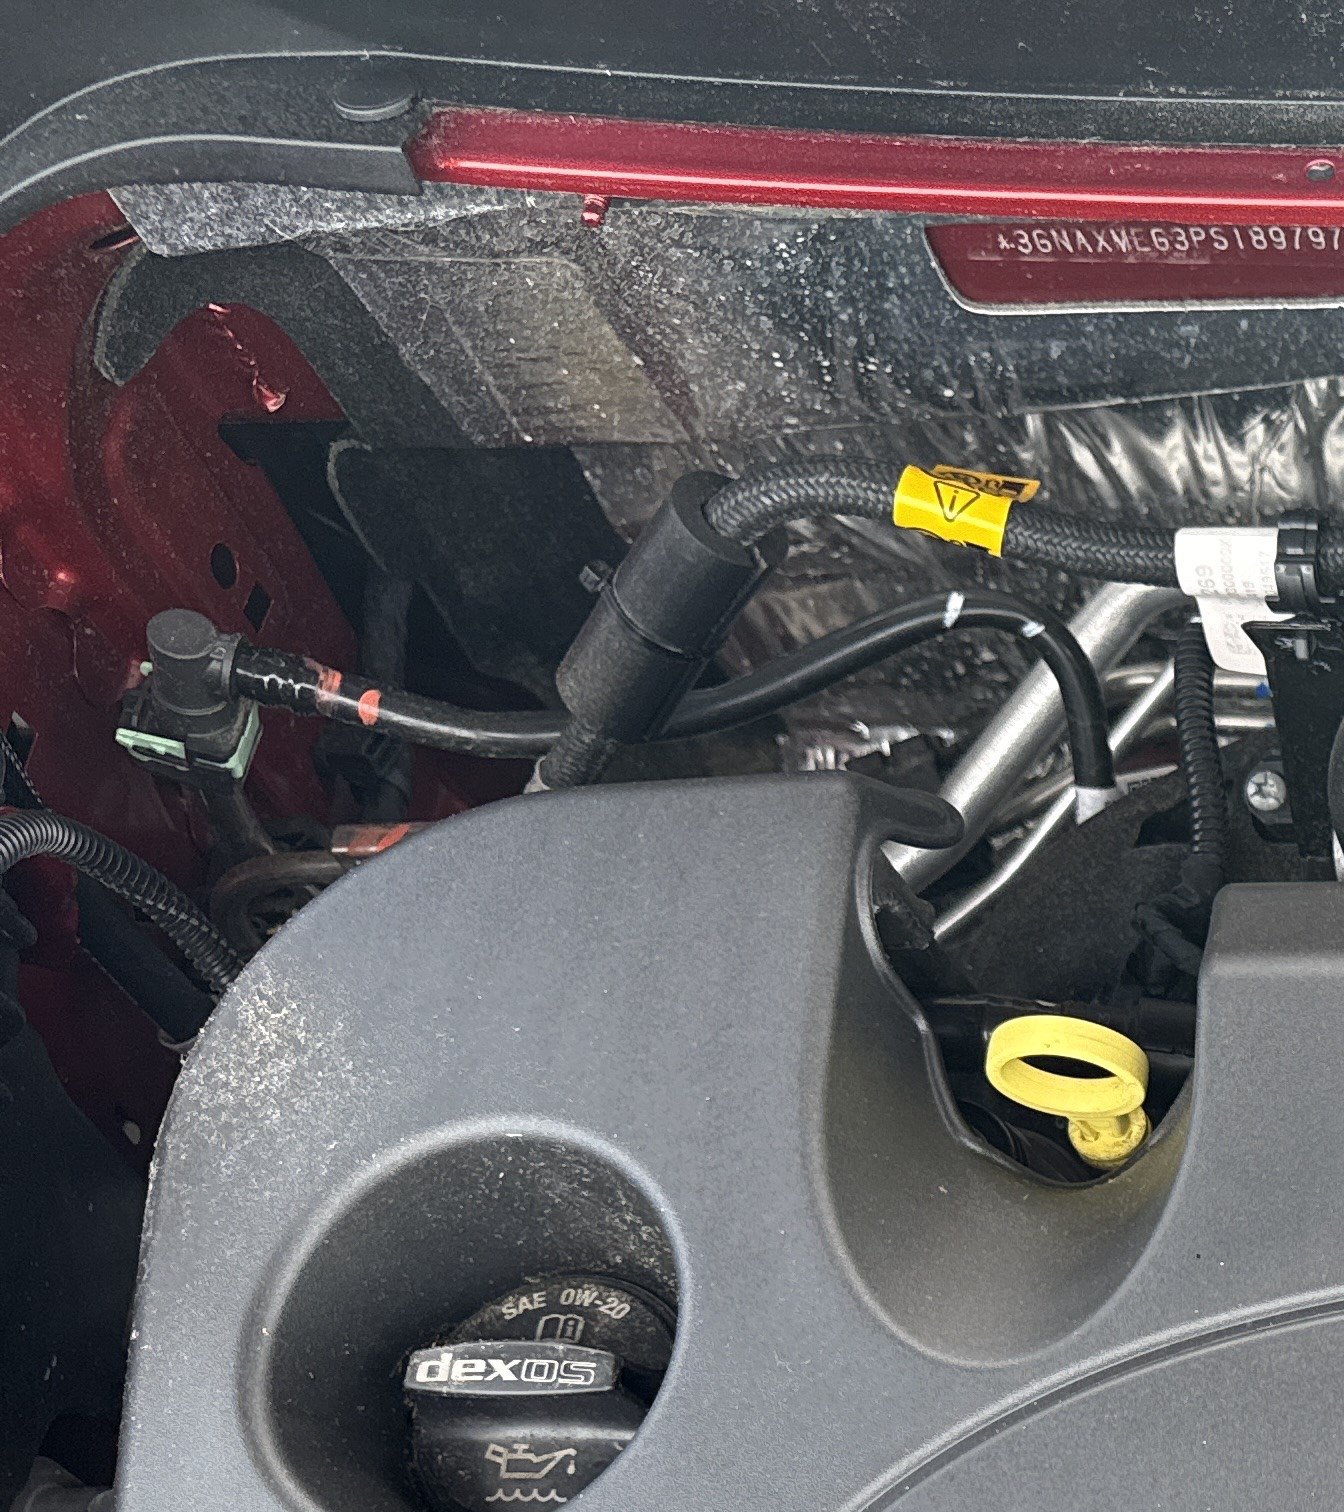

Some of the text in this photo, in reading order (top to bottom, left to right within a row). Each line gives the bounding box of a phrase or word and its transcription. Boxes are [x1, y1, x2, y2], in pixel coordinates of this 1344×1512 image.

[502, 1288, 631, 1320] SAE 0W-20
[415, 1353, 597, 1385] dexos
